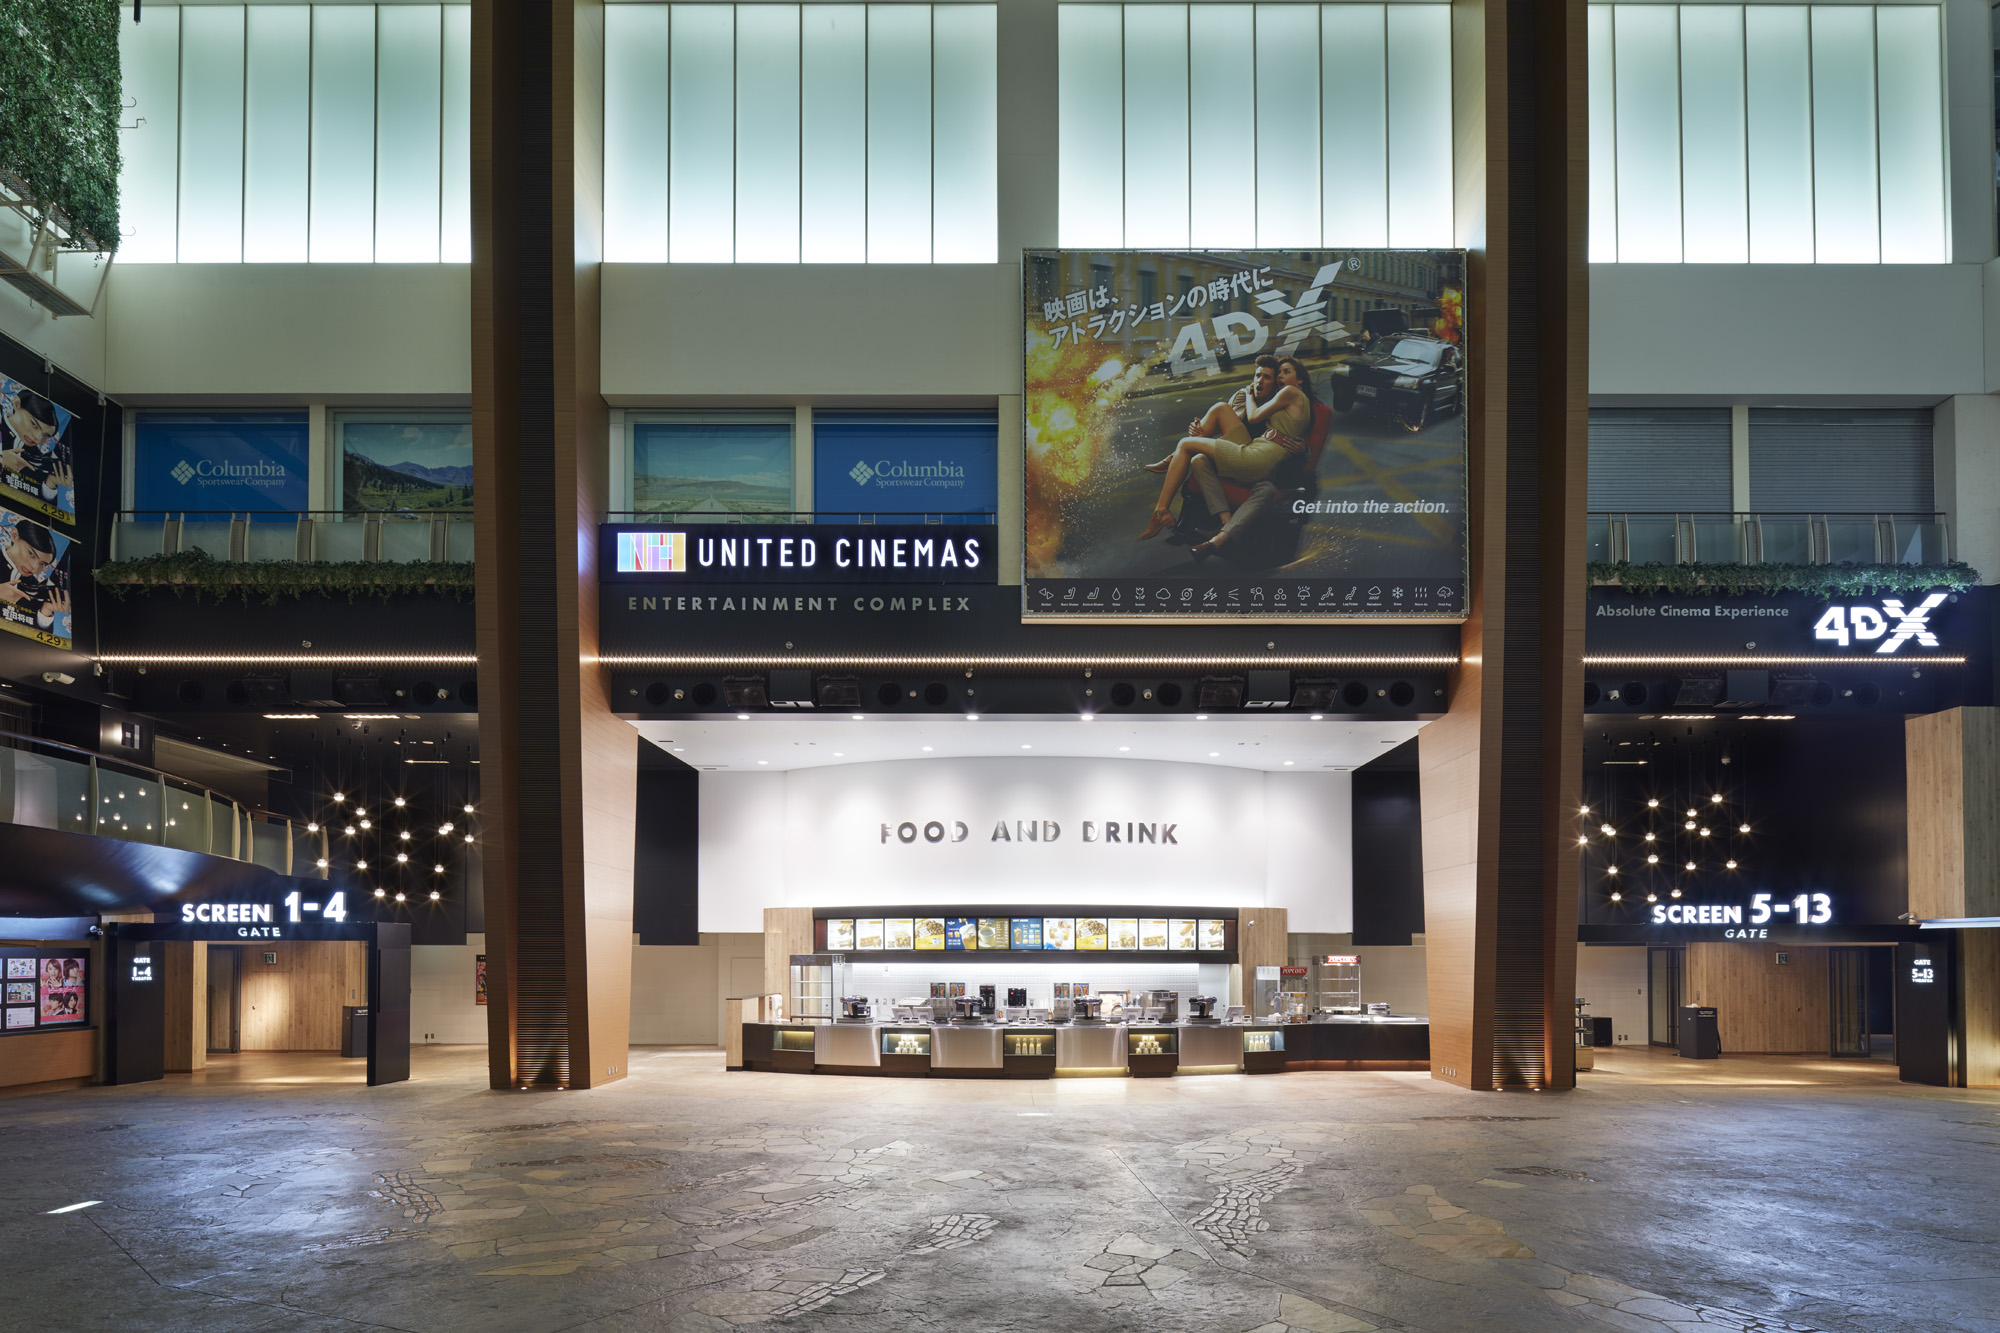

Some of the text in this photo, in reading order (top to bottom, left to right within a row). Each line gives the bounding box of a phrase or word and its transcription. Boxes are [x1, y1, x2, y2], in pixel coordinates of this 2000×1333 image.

[1043, 284, 1120, 323] 映画は、
[1048, 265, 1274, 350] アトラクションの時代に
[196, 460, 286, 477] Columbia
[874, 460, 964, 477] Columbia
[196, 477, 286, 488] Sportswear Company
[875, 477, 965, 489] Sportswear Company
[41, 503, 65, 520] 4.29
[1292, 499, 1450, 514] Get into the action.
[698, 538, 980, 568] UNITED CINEMAS
[628, 596, 970, 611] ENTERTAINMENT COMPLEX
[1596, 604, 1789, 620] Absolute Cinema Experience
[1813, 593, 1949, 654] 4DX
[36, 631, 61, 646] 4.29
[880, 820, 1179, 845] FOOD AND DRINK
[182, 891, 348, 923] SCREEN 1-4
[1652, 892, 1833, 925] SCREEN 5-13
[237, 926, 282, 938] GATE
[1724, 928, 1769, 939] GATE
[1911, 968, 1934, 979] 5-13
